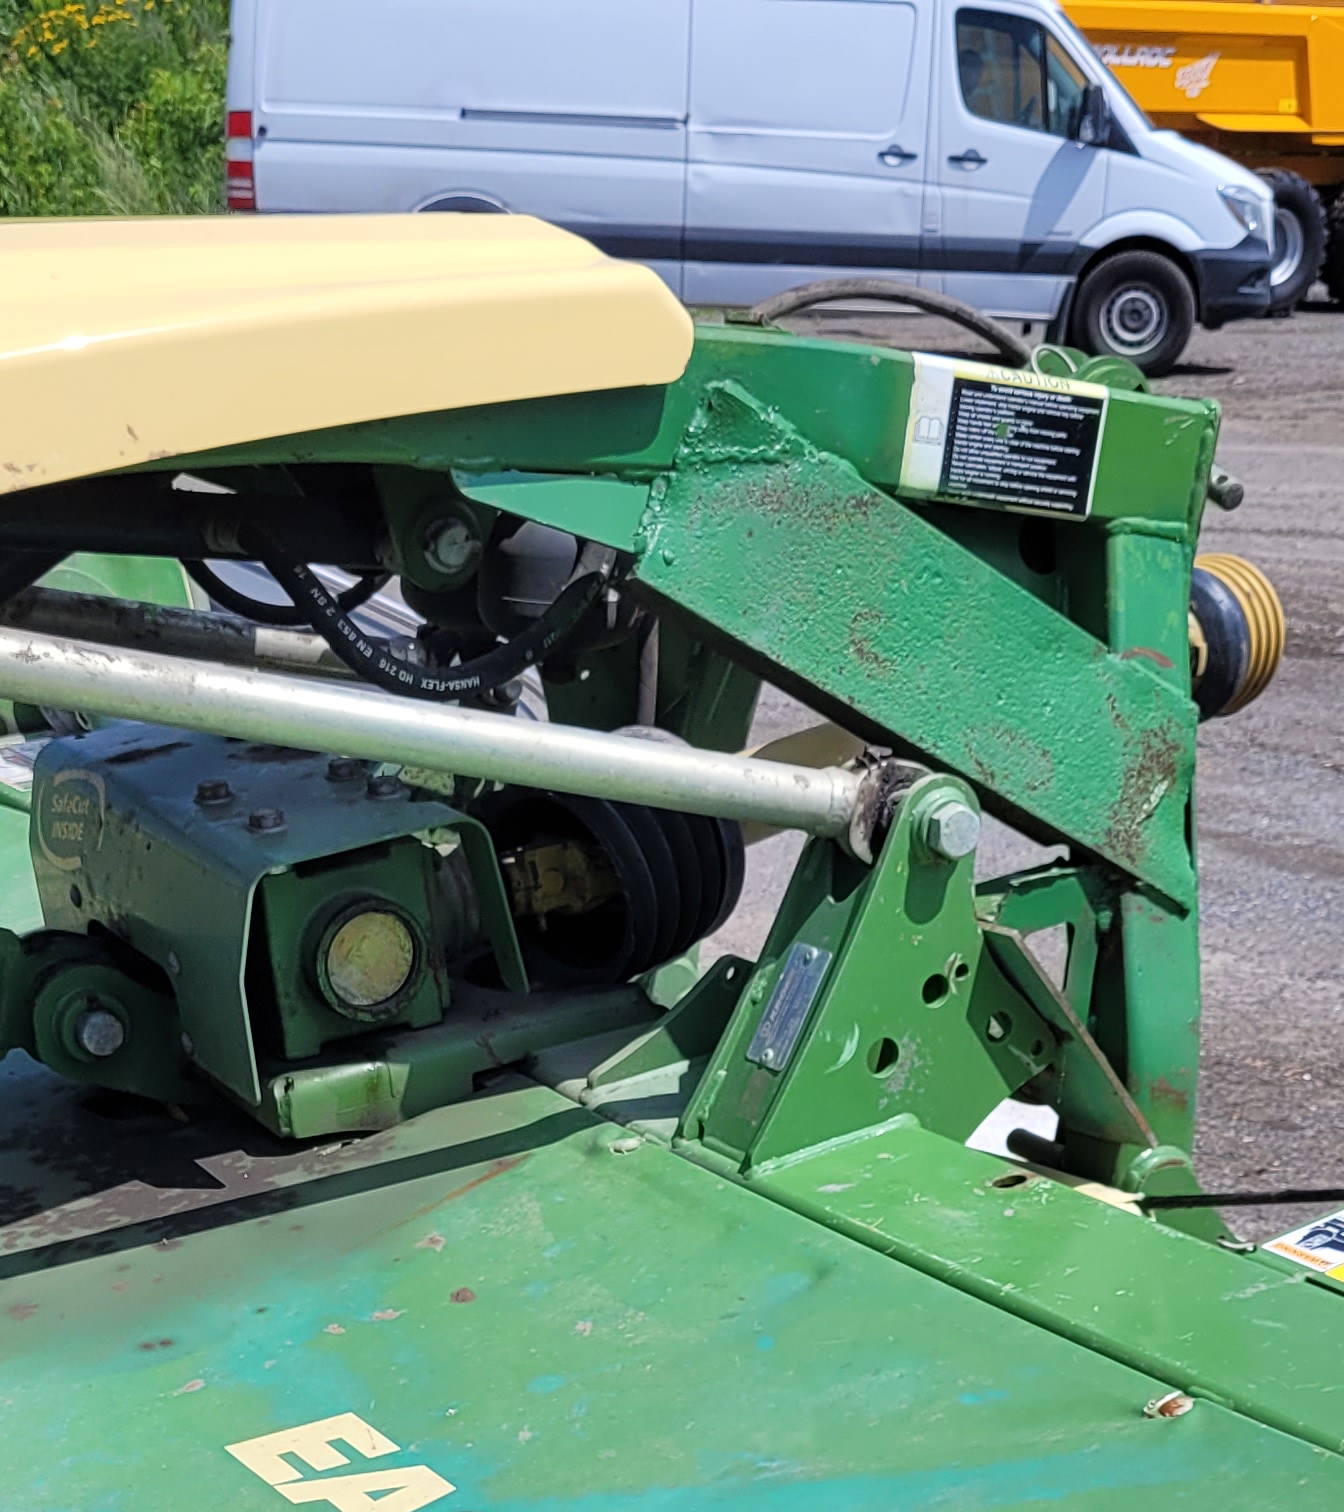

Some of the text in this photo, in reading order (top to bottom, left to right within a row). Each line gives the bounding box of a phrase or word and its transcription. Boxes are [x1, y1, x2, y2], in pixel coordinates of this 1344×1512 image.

[354, 639, 374, 660] EN
[378, 657, 398, 677] 216
[398, 669, 414, 685] HD
[420, 675, 480, 692] HANSA-FLEX
[52, 820, 85, 841] INSIDE
